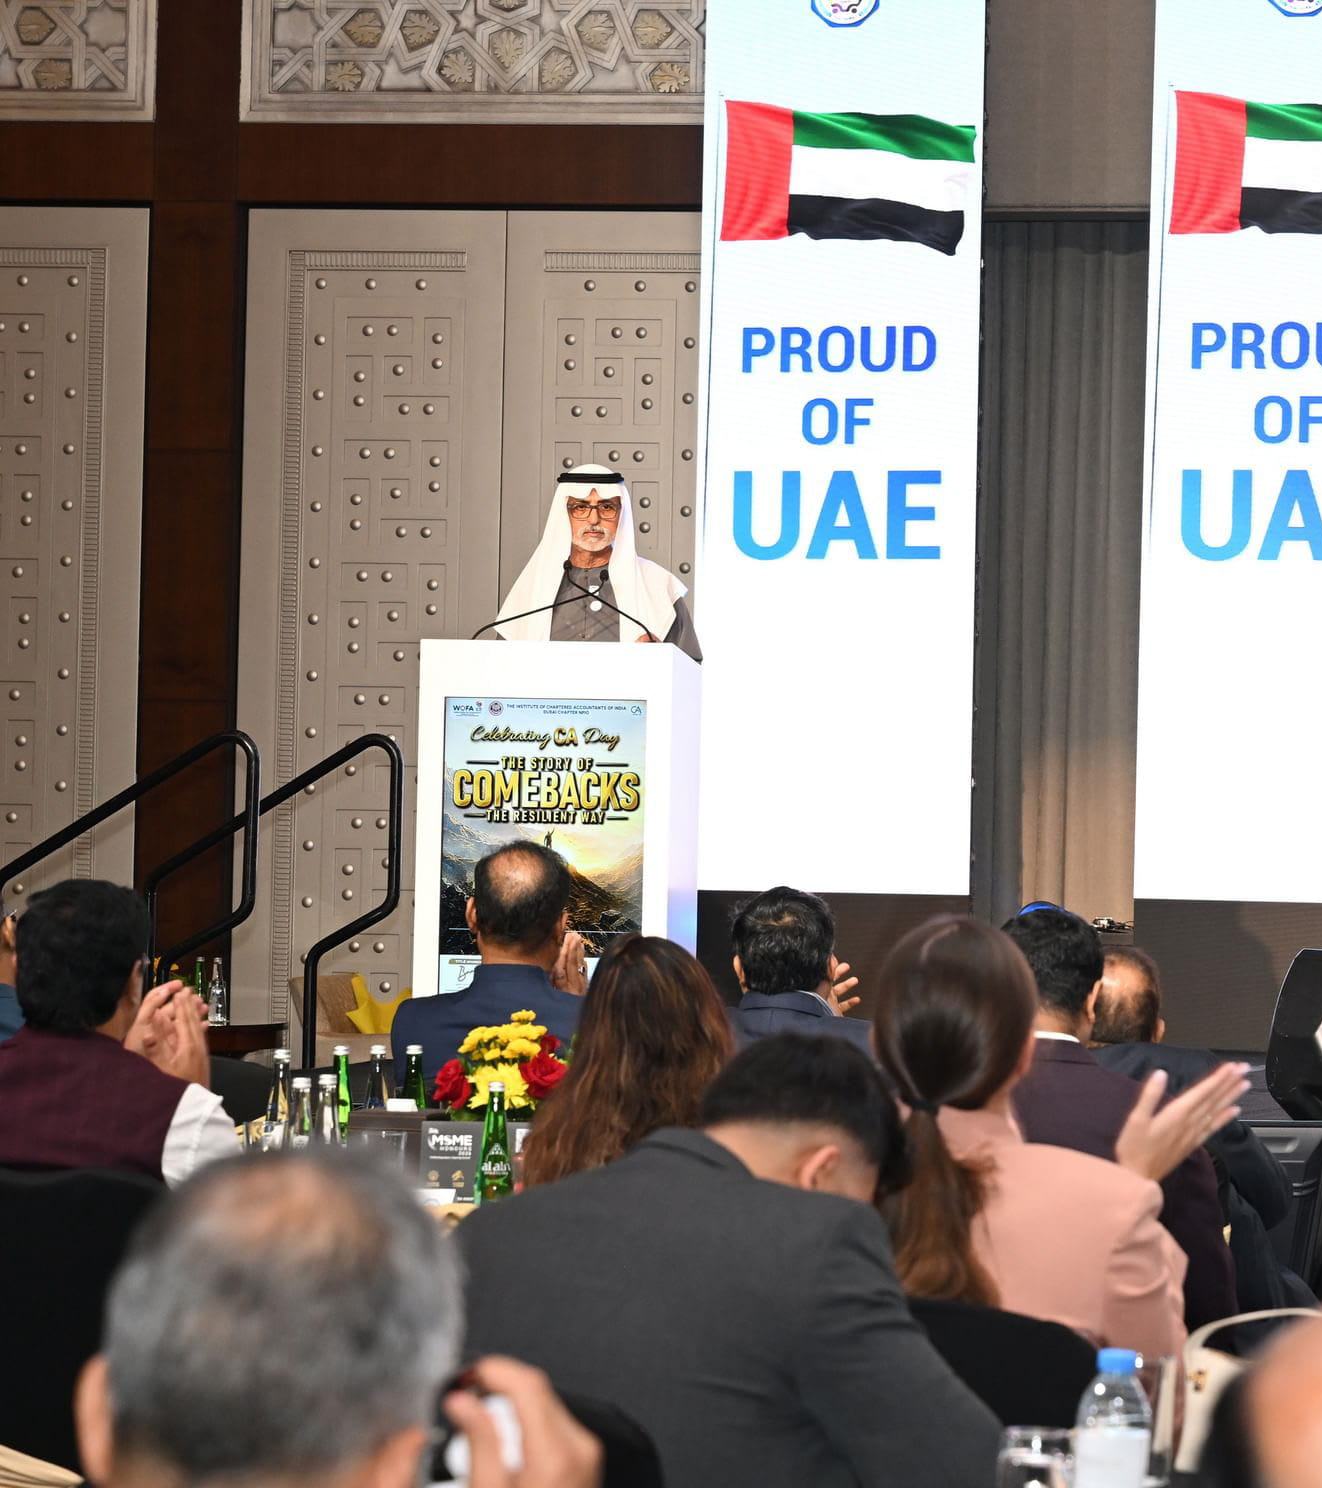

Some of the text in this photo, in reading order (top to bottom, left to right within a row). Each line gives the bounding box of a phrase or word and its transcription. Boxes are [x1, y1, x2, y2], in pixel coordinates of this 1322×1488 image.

[742, 325, 937, 373] PROUD
[801, 398, 874, 445] OF
[732, 470, 941, 560] UAE
[470, 725, 620, 751] Celebrating CA Day
[501, 756, 594, 771] THE STORY OF
[453, 769, 640, 811] COMEBACKS
[485, 809, 606, 824] THE RESILIENT WAY
[431, 1134, 472, 1146] MSME
